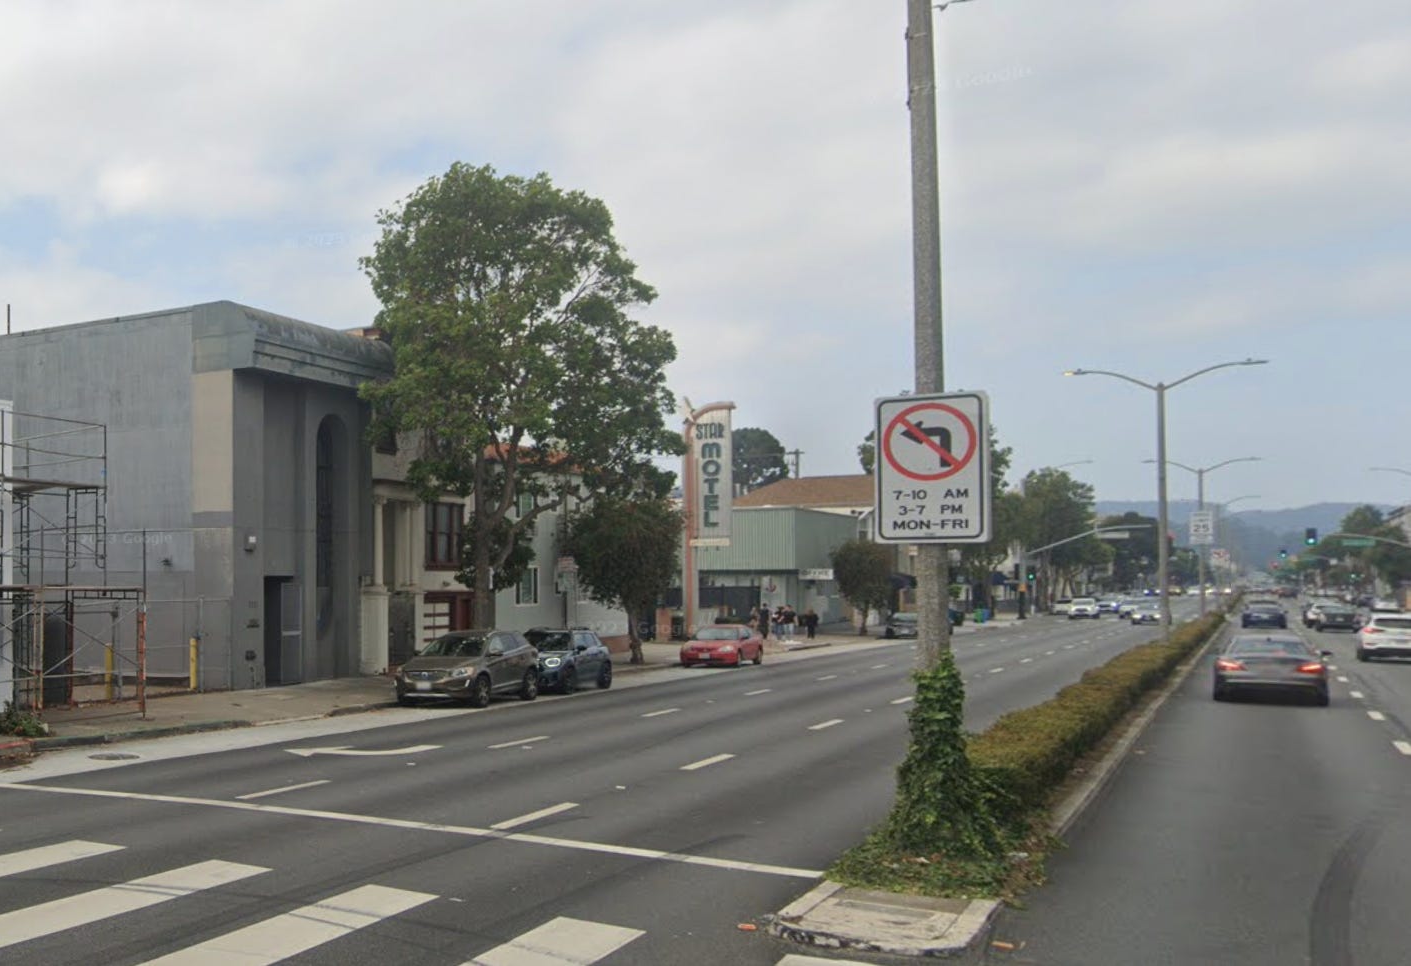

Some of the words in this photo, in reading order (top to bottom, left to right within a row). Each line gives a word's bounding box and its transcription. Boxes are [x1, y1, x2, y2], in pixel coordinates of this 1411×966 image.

[696, 423, 724, 439] STAR
[701, 442, 721, 528] MOTEL
[893, 489, 927, 500] 7-10
[943, 488, 969, 499] AM
[898, 505, 926, 516] 3-7
[940, 504, 963, 514] PM
[892, 519, 969, 530] MON-FRI
[1193, 523, 1209, 532] 25
